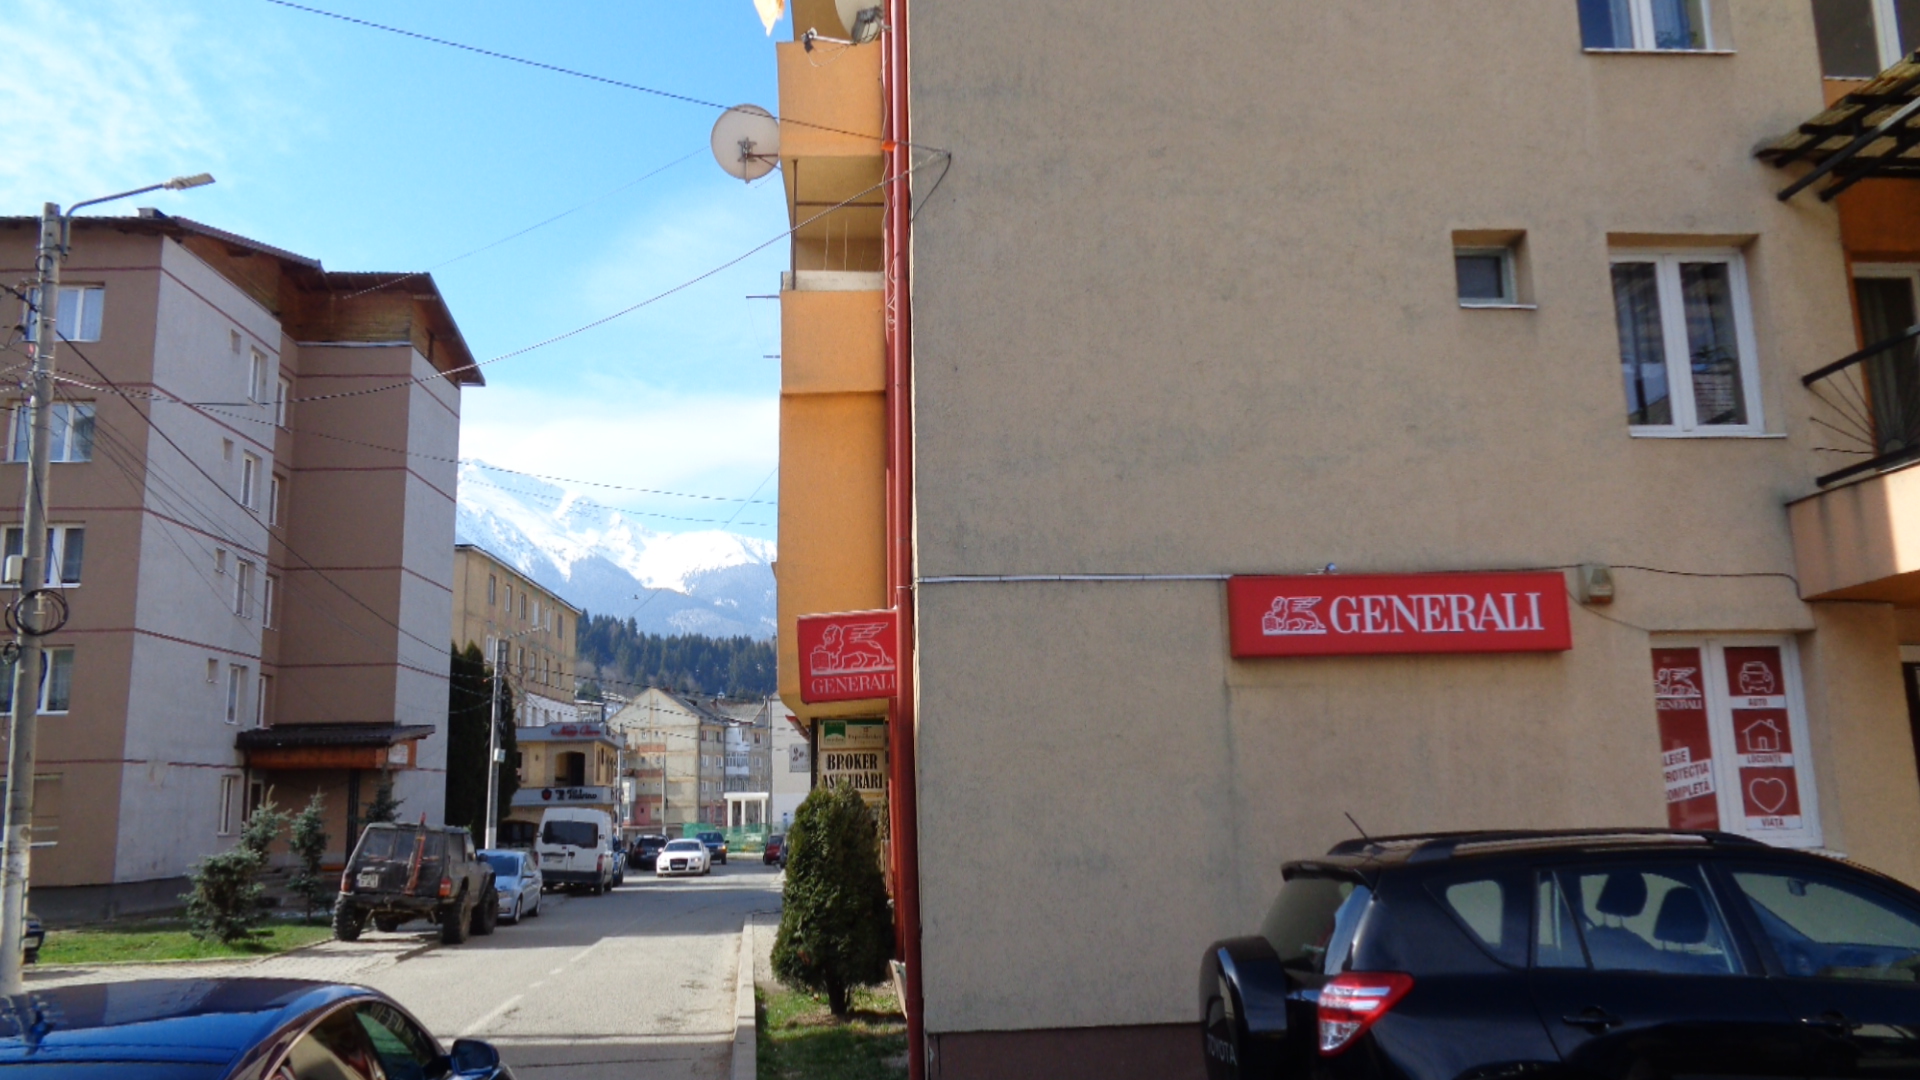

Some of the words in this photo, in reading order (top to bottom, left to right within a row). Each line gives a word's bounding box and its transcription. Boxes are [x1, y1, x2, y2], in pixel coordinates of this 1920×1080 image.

[1329, 592, 1545, 634] GENERALI
[811, 673, 896, 695] GENERALI
[827, 753, 878, 770] BROKER
[1662, 750, 1687, 766] LEGE
[1663, 762, 1710, 783] ROTECȚIA
[1666, 778, 1711, 800] OMPLETĂ
[1206, 1032, 1238, 1066] TOYOTA
